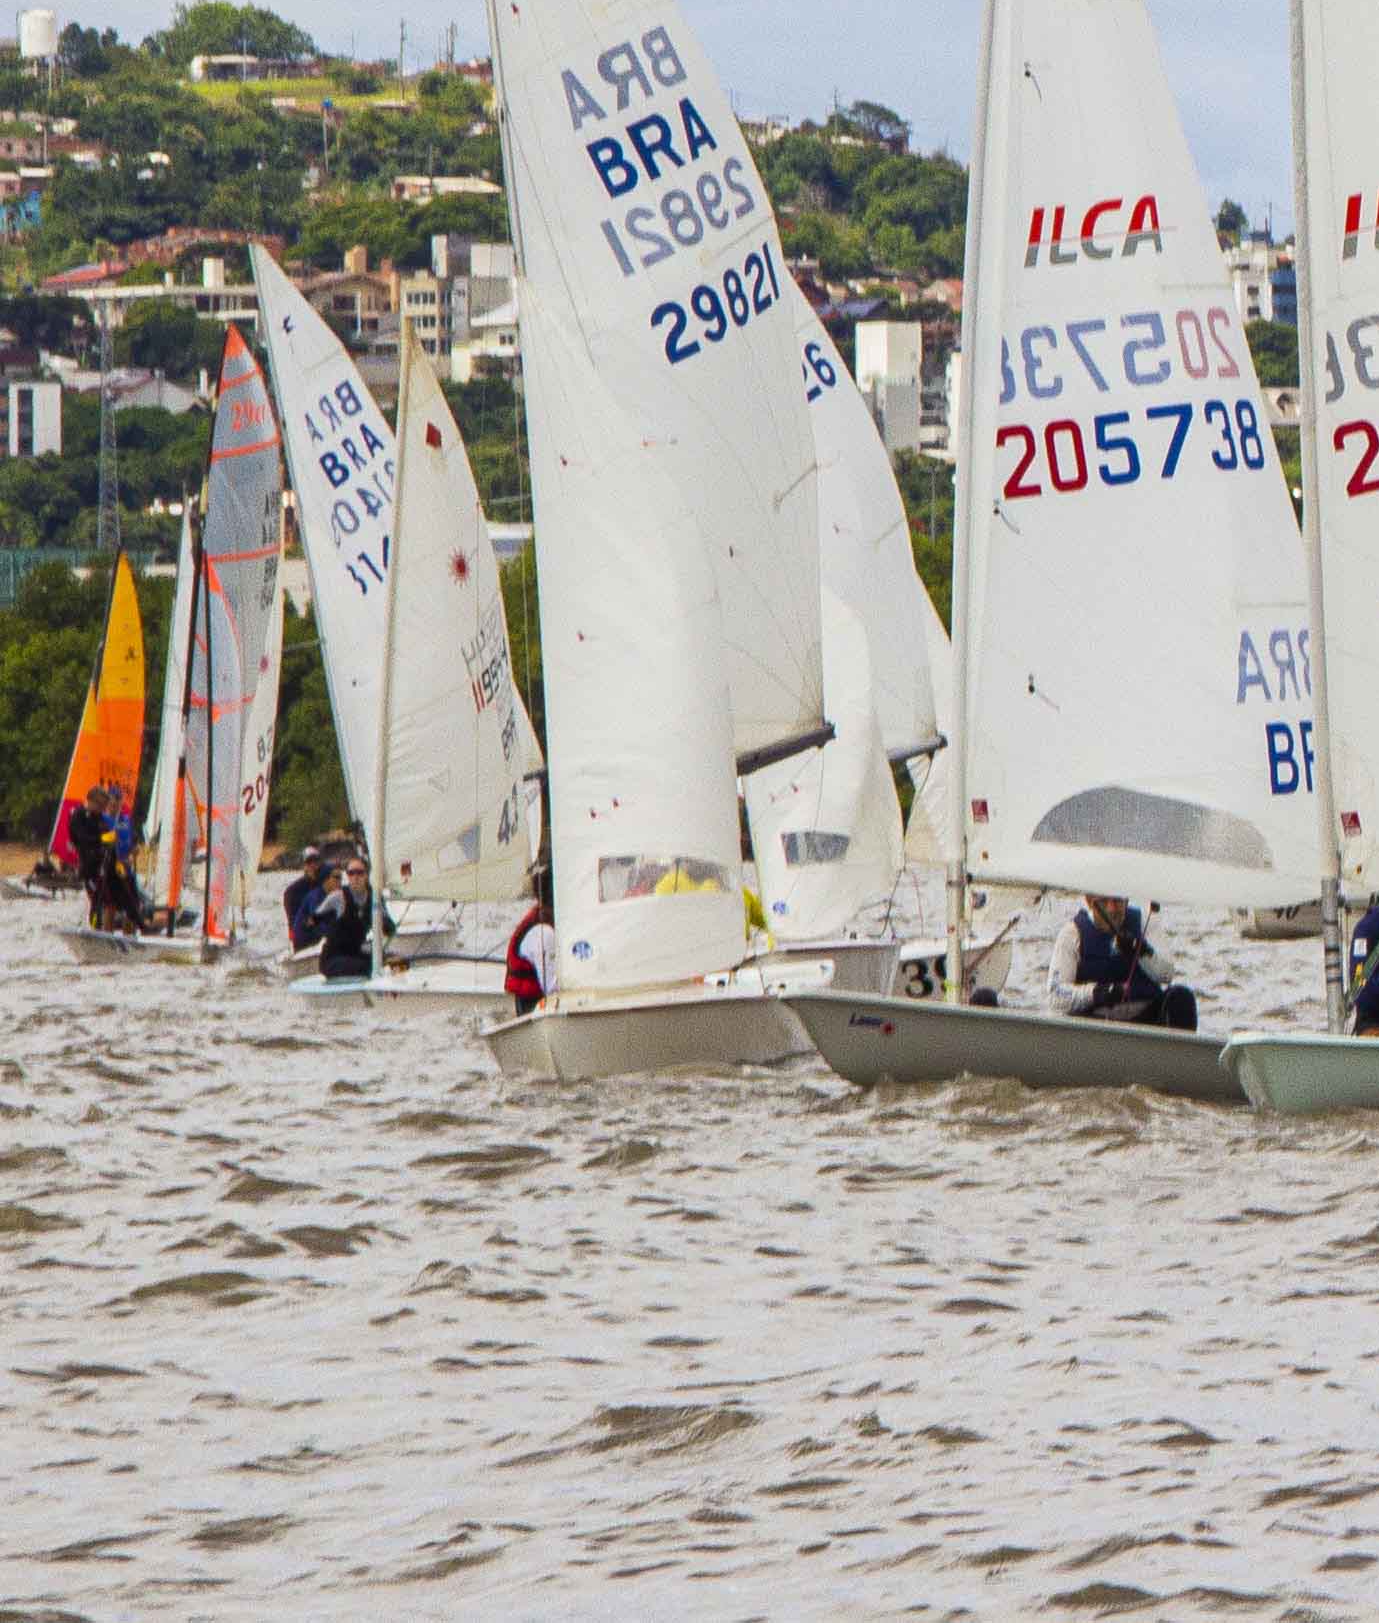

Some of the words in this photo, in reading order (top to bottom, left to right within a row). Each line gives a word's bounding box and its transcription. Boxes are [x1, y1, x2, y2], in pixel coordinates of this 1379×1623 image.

[586, 97, 717, 198] BRA
[1024, 194, 1163, 268] ILCA
[650, 242, 779, 364] 29821
[320, 423, 384, 489] BRA
[996, 399, 1265, 500] 205738
